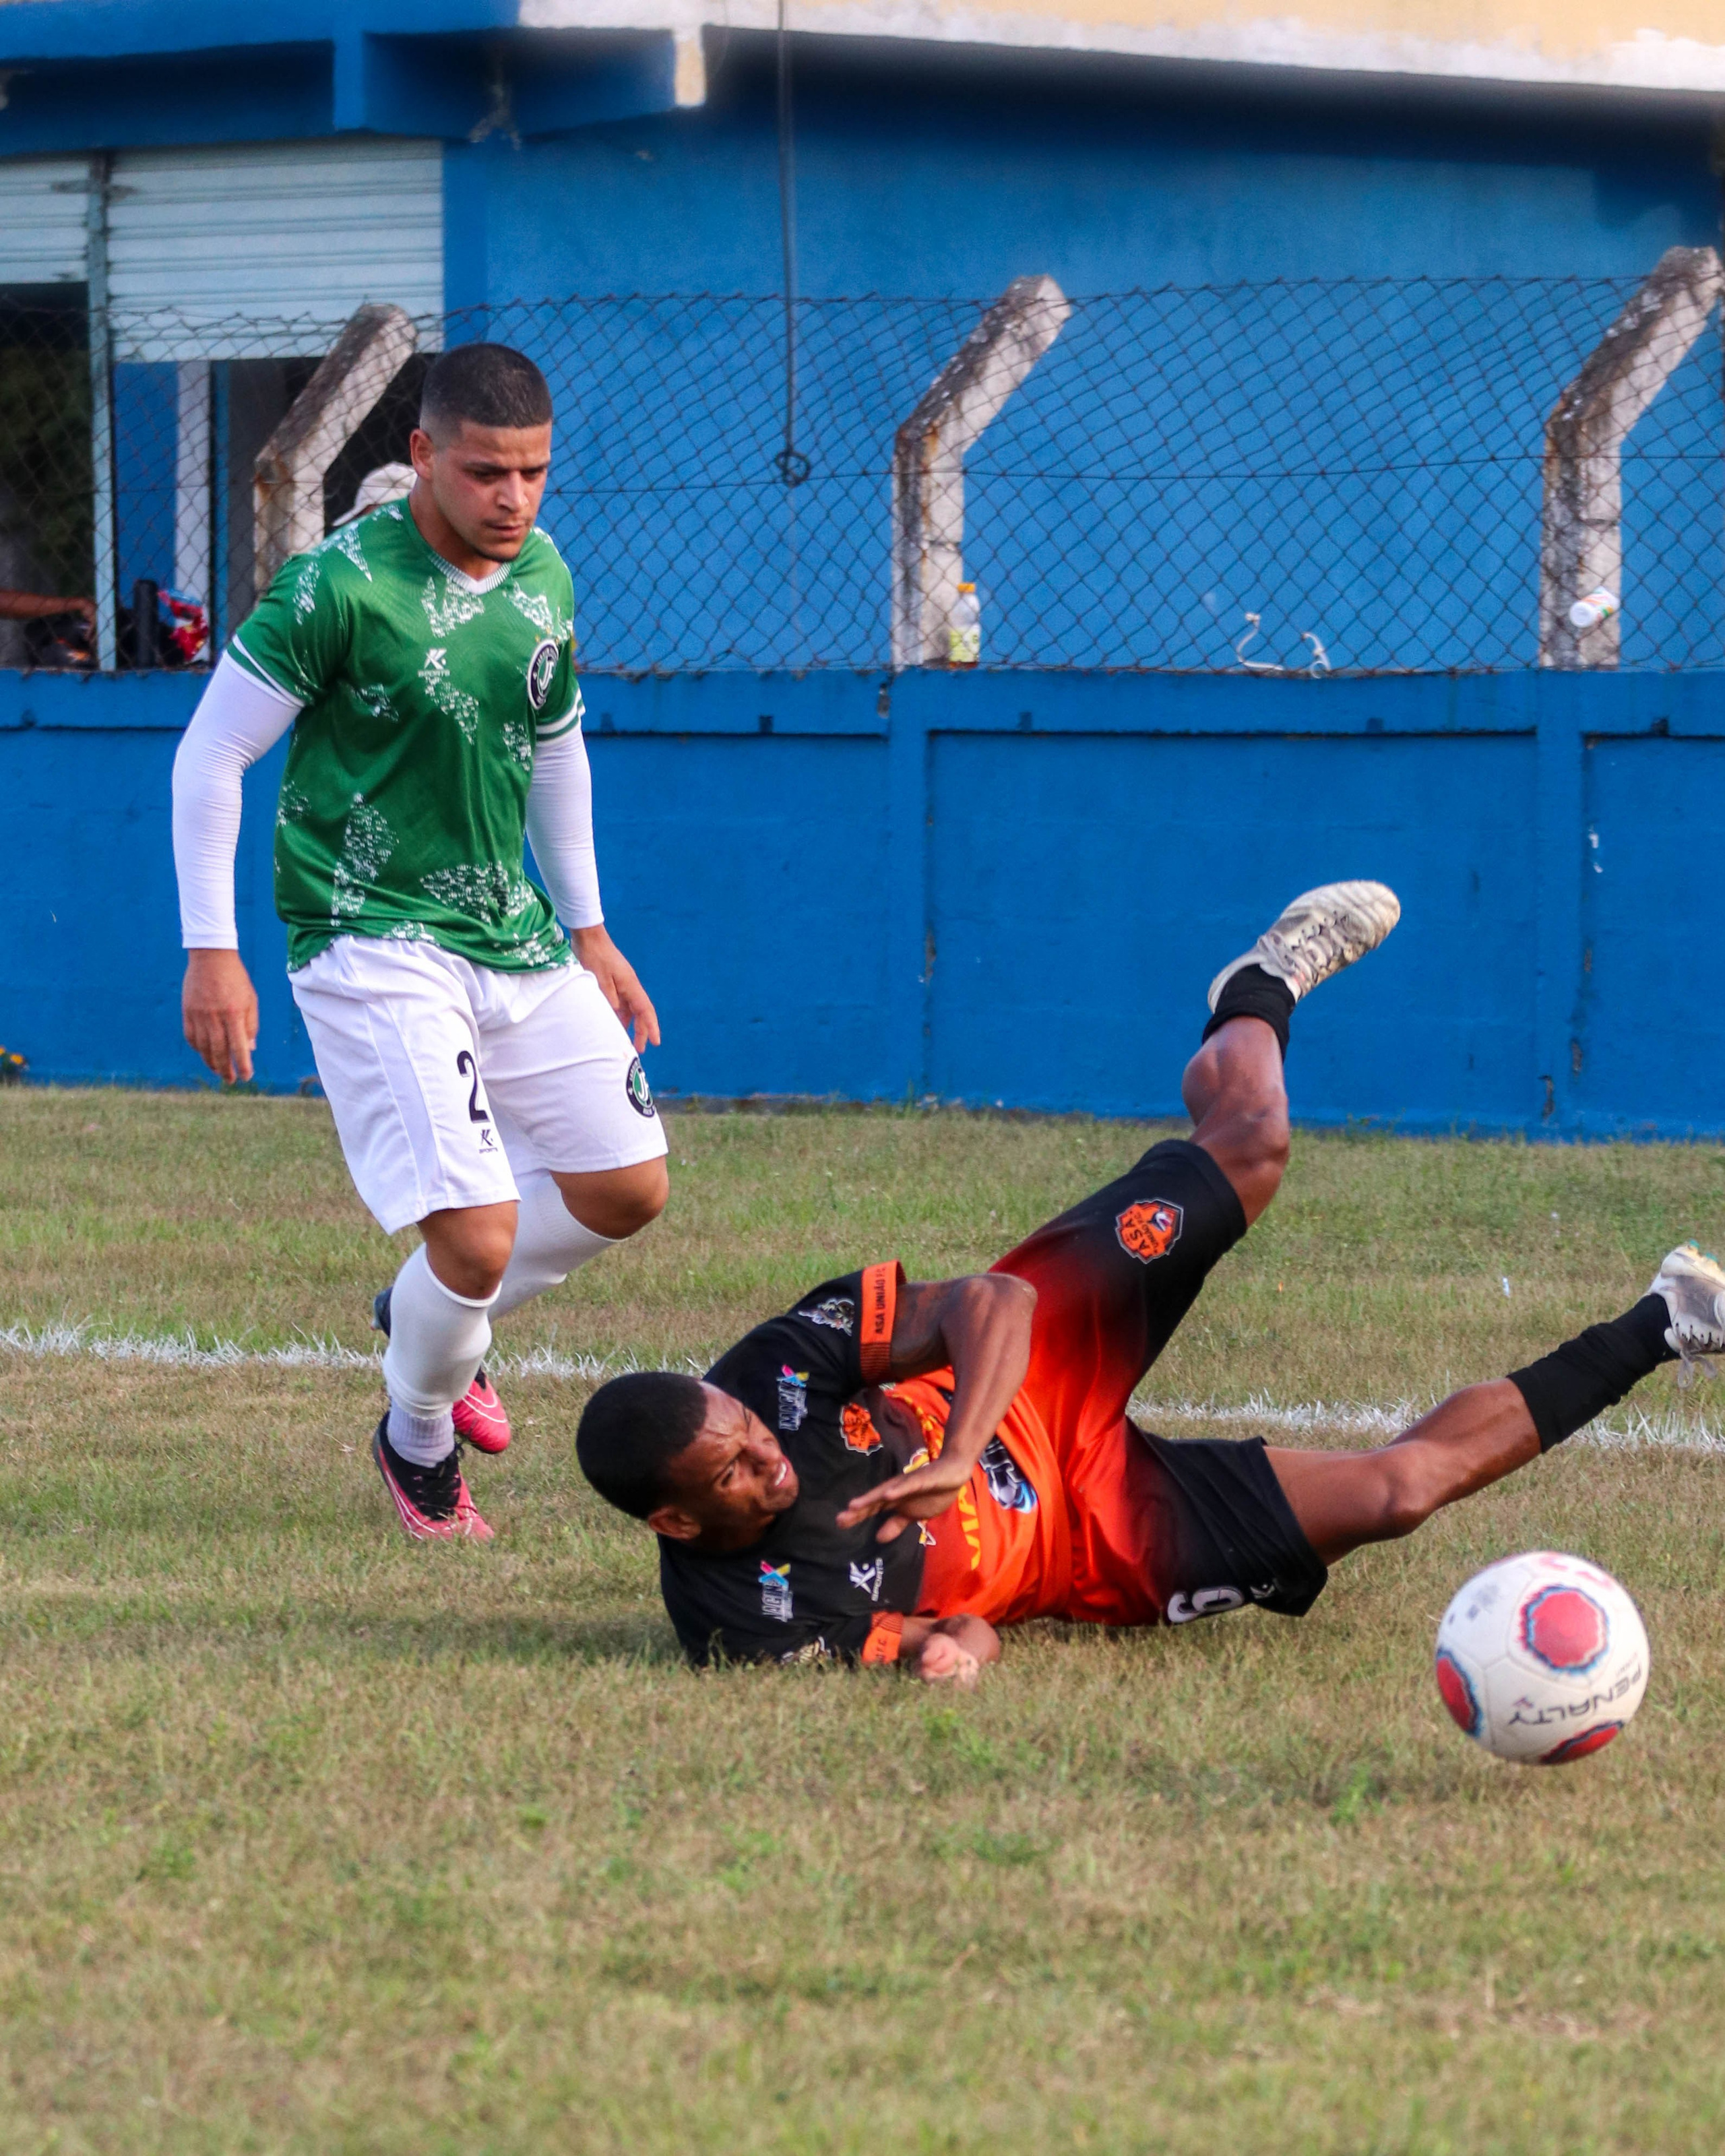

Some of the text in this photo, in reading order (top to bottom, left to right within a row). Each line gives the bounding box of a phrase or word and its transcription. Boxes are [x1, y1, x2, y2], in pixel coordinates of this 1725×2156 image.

[457, 1050, 490, 1124] 2
[1125, 1217, 1151, 1250] ASA
[874, 1279, 886, 1310] UNIÃO
[875, 1313, 885, 1334] ASA
[871, 1557, 884, 1602] SPORTS
[1507, 1663, 1641, 1726] PENALTY
